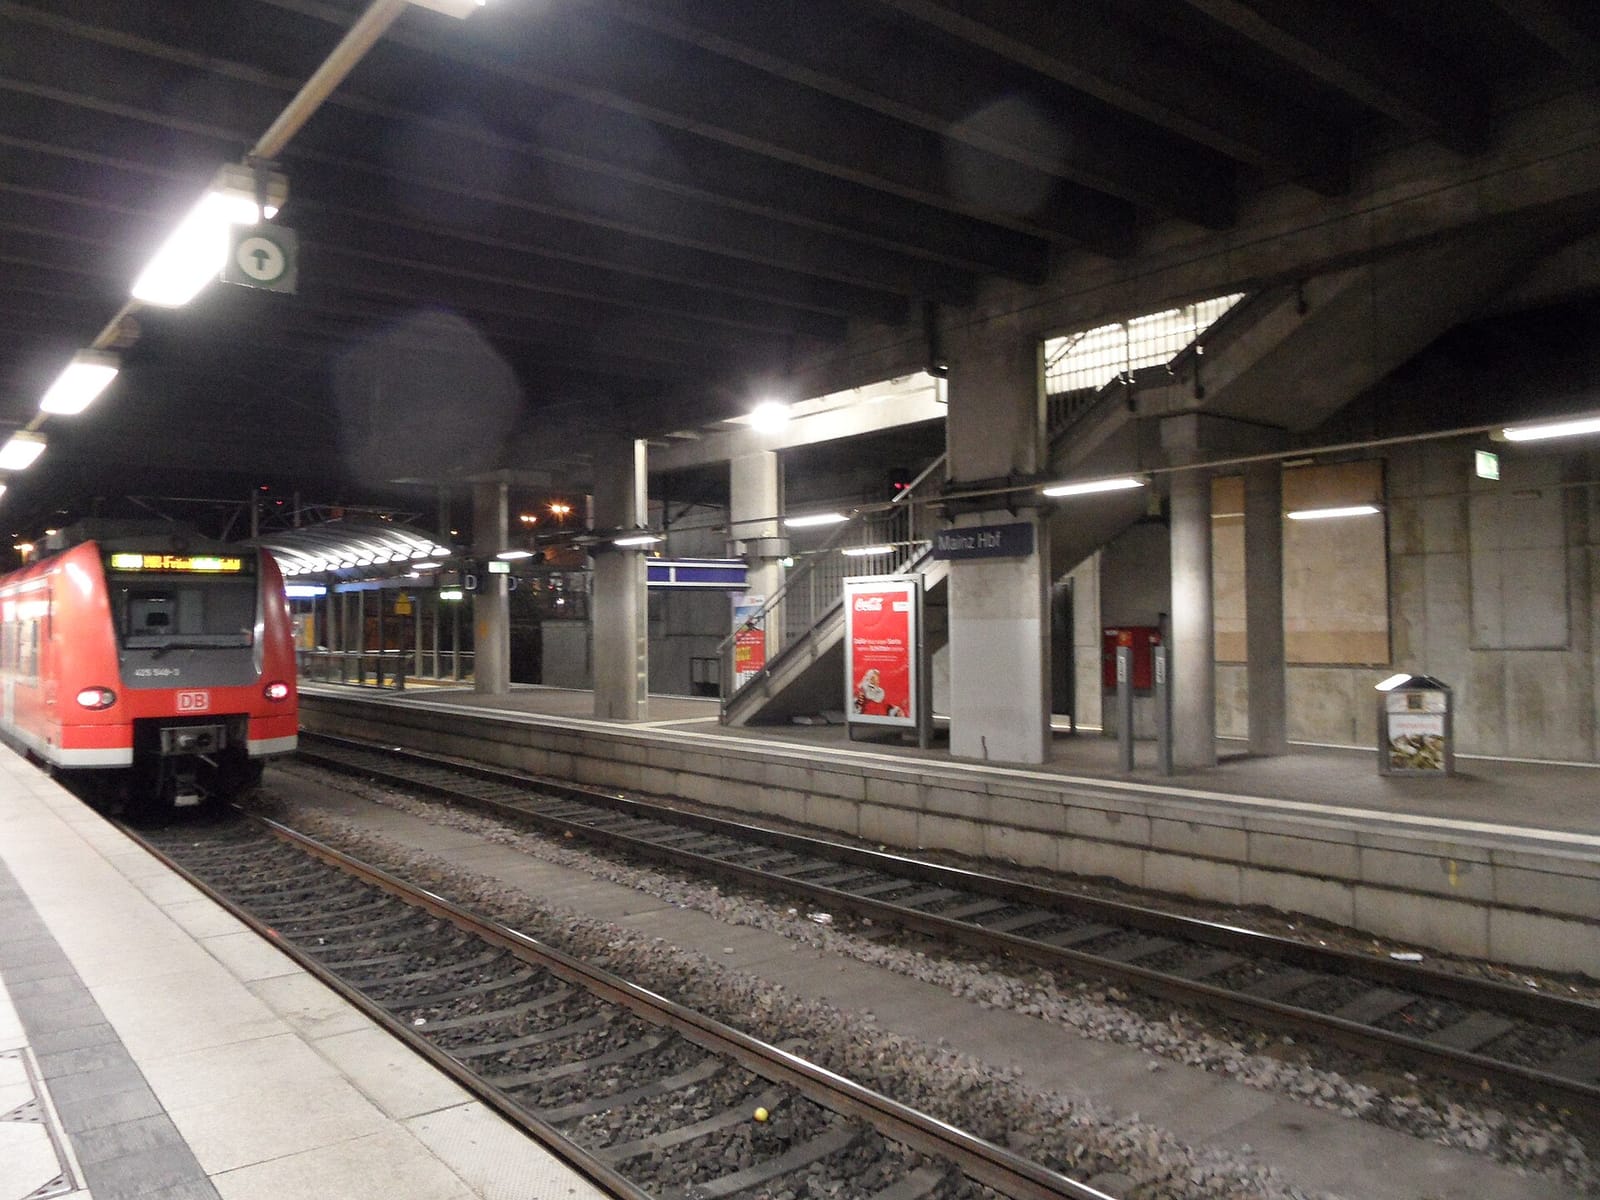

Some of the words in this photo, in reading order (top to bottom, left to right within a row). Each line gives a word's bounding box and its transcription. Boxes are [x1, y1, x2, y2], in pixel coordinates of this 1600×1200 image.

[938, 535, 975, 551] Mainz
[977, 531, 1001, 549] Hbf
[180, 693, 205, 710] DB
